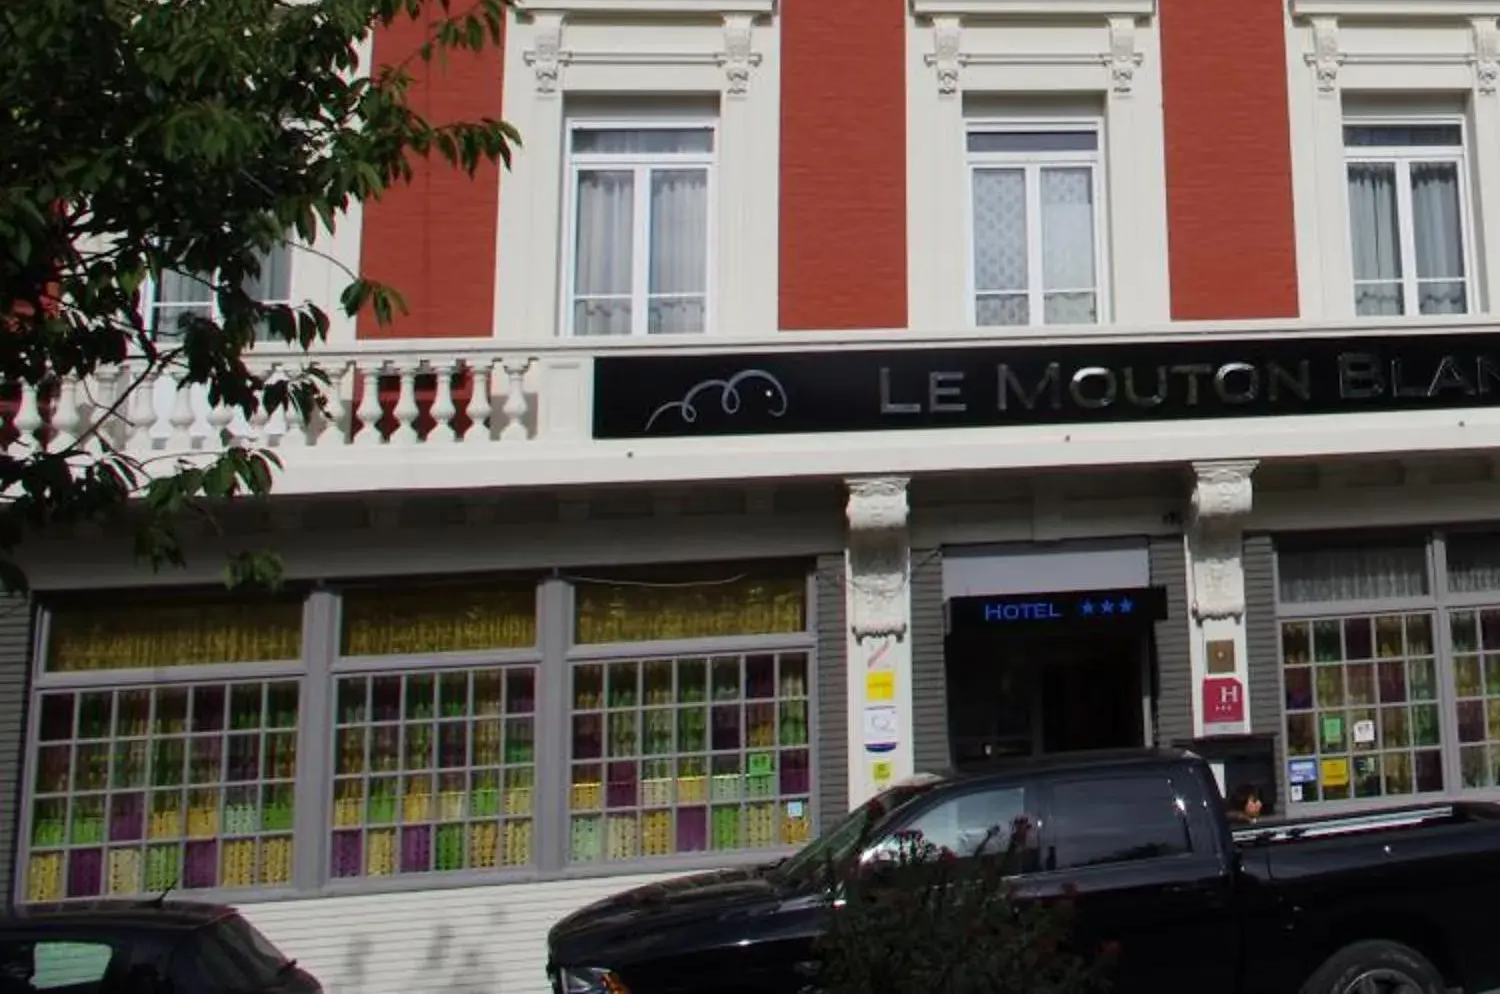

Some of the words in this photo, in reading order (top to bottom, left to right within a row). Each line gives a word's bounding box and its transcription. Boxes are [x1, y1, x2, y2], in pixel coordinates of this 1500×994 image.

[879, 366, 967, 413] LE
[997, 360, 1311, 411] MOUTON
[985, 603, 1062, 620] HOTEL
[1221, 685, 1238, 703] H
